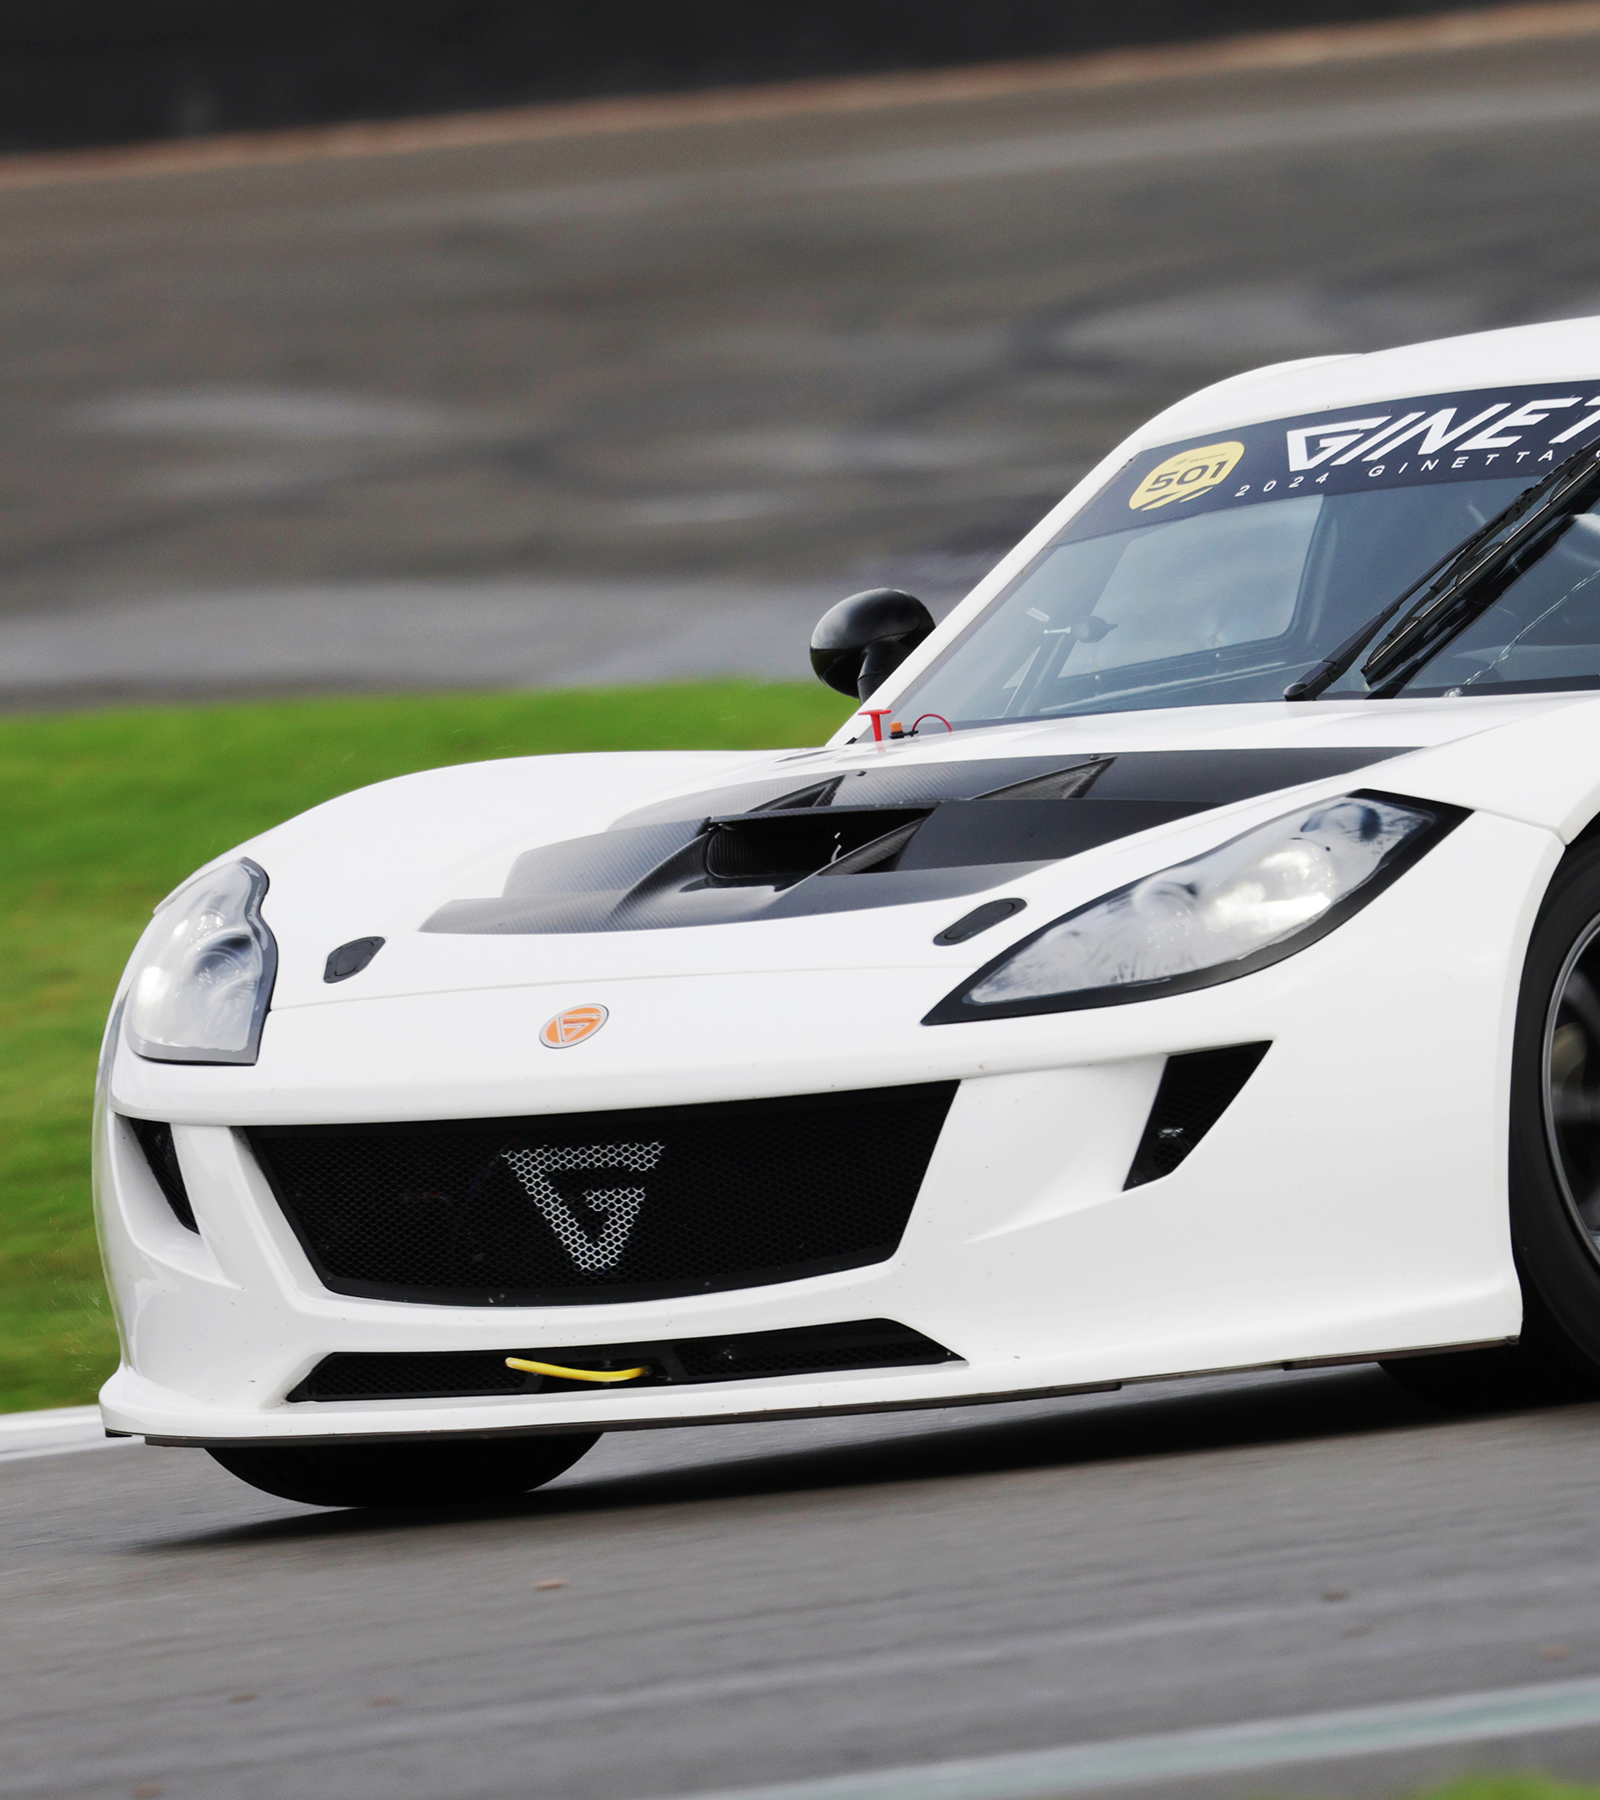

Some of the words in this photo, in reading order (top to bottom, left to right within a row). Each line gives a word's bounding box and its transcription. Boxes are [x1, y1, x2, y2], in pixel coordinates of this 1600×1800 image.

[1145, 459, 1229, 493] 501
[1234, 472, 1330, 497] 2024
[1368, 449, 1554, 478] GINETTA
[500, 1141, 665, 1270] G
